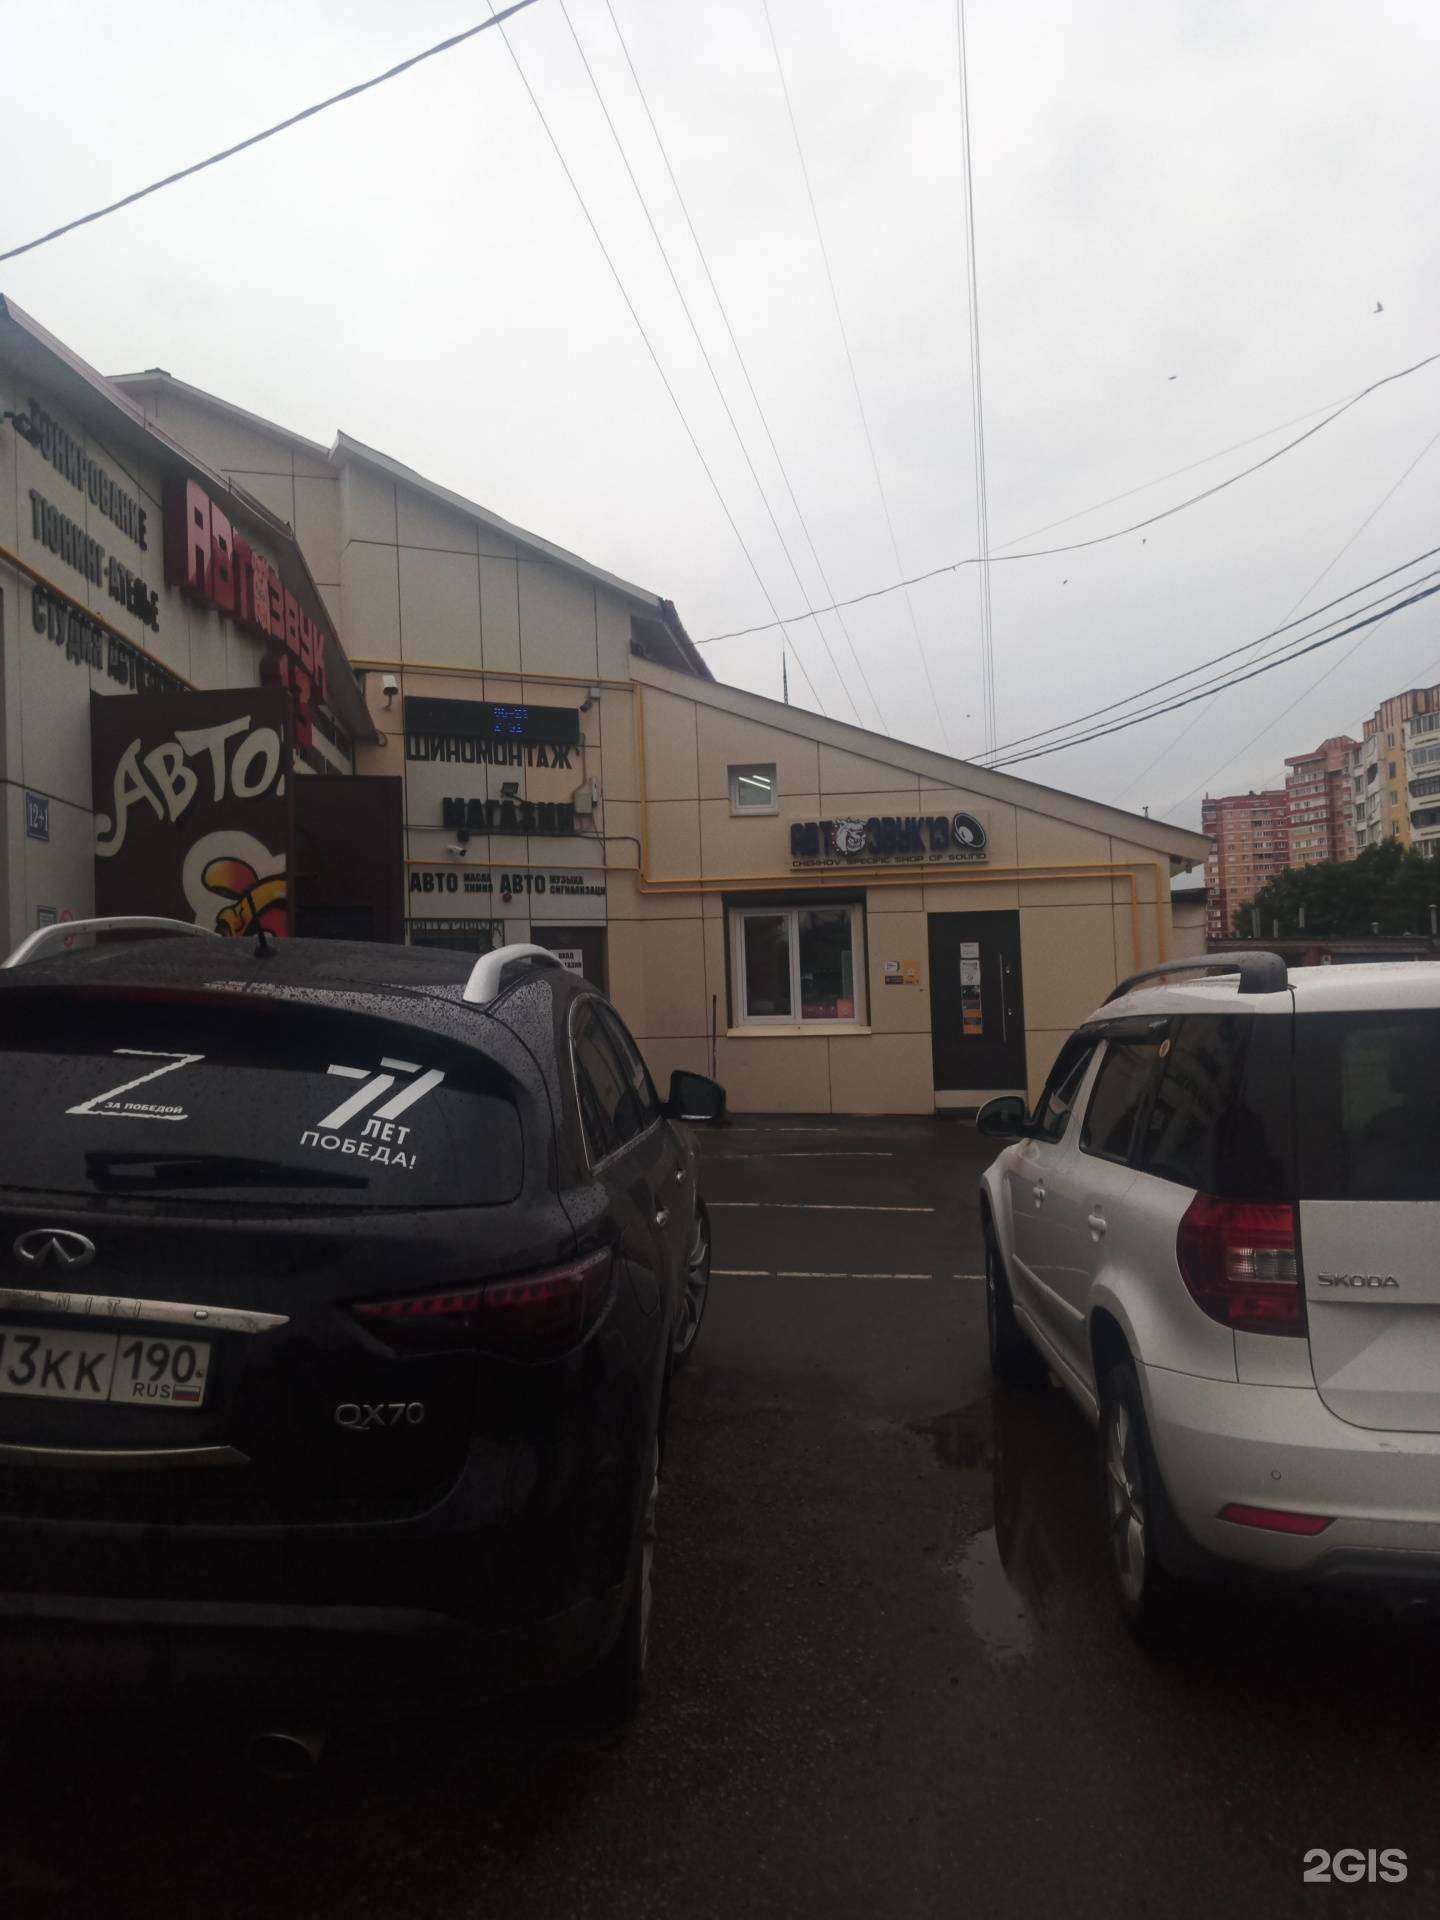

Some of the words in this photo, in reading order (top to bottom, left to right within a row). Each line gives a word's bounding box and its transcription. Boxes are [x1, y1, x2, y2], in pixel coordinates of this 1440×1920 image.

[407, 735, 573, 769] ШИНОМОНТАЖ
[95, 715, 287, 858] АВТО
[894, 855, 924, 863] SHOP
[410, 872, 458, 893] АВТО
[500, 874, 546, 894] АВТО
[549, 875, 584, 885] МУЗЫКА
[316, 1056, 446, 1130] 77
[105, 1101, 121, 1109] ЗА
[124, 1102, 184, 1114] ПОБЕДОЙ
[361, 1119, 410, 1145] ЛЕТ
[299, 1130, 418, 1170] ПОБЕДА!
[122, 1339, 197, 1383] 190
[132, 1382, 171, 1399] RUS
[334, 1402, 425, 1431] QX70
